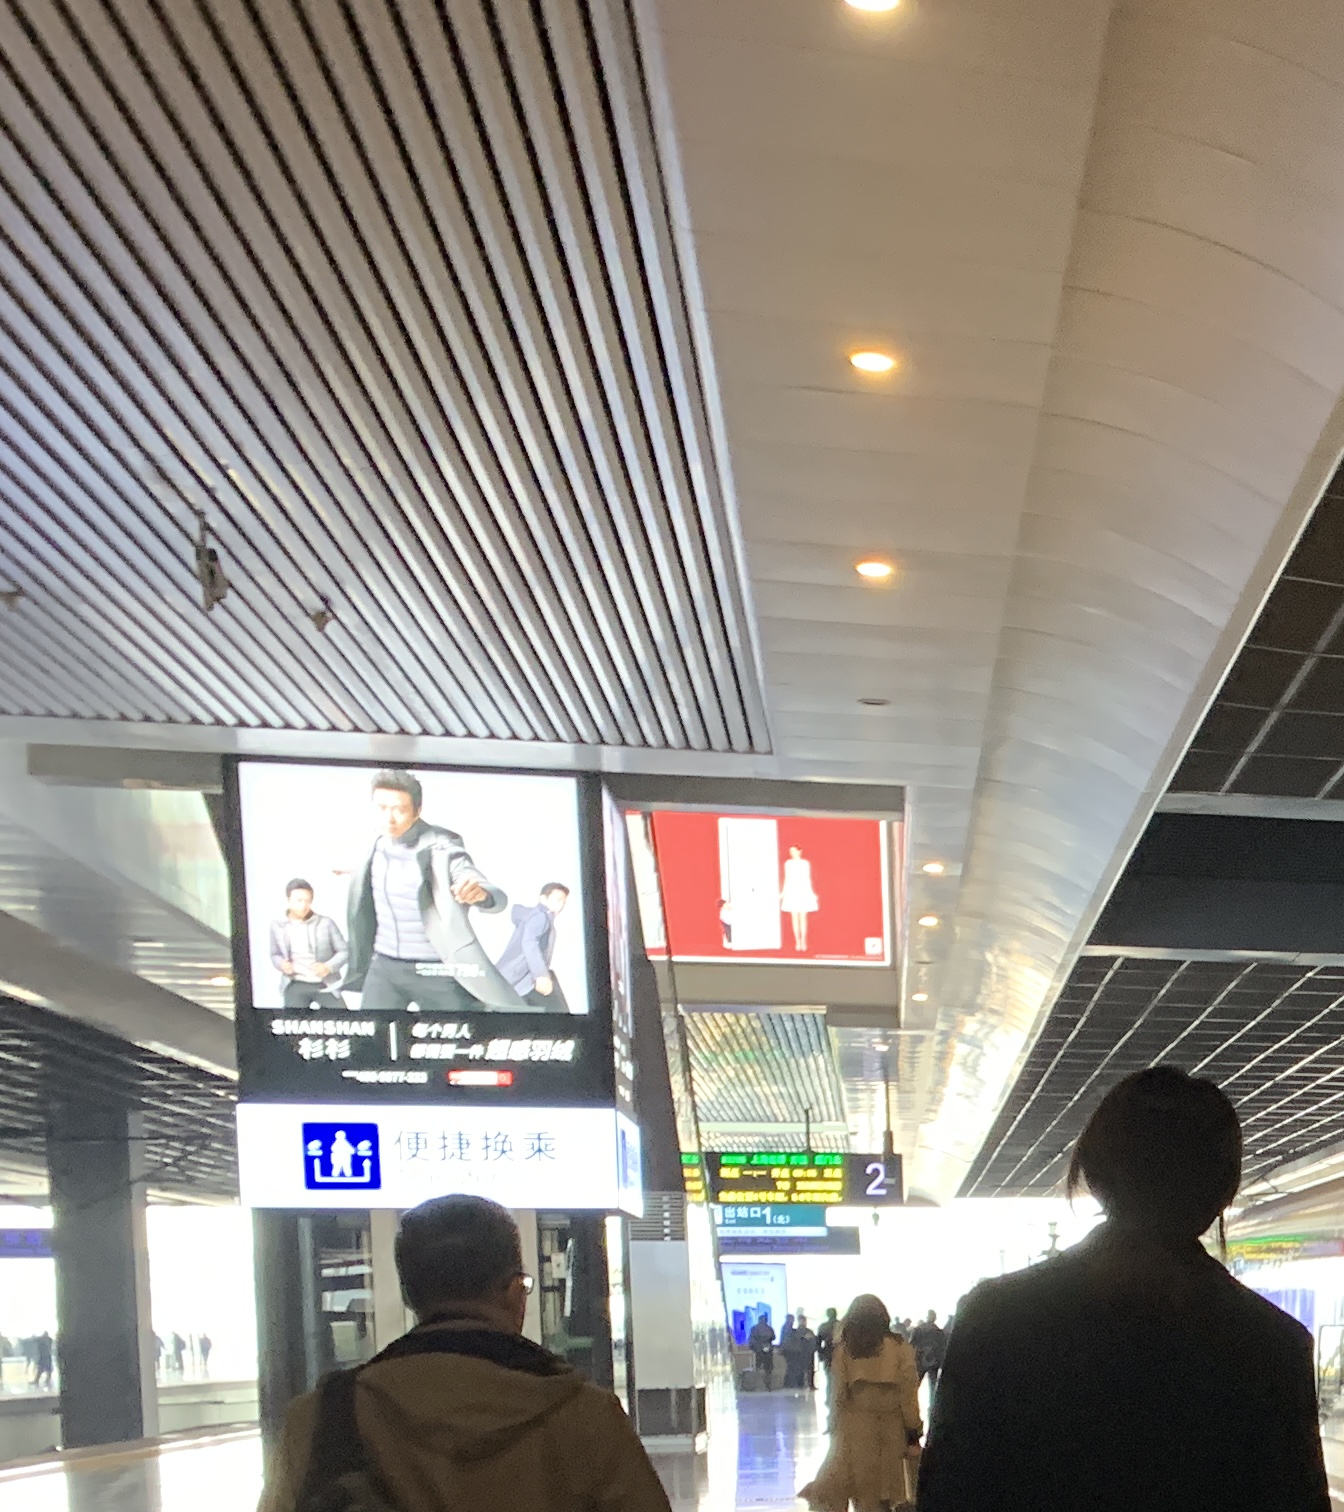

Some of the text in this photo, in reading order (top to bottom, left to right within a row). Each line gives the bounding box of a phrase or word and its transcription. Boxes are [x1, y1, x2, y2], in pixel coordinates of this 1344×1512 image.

[271, 1019, 376, 1037] SHANSHAN
[297, 1037, 351, 1061] 杉杉
[394, 1129, 557, 1162] 便捷换乘
[864, 1161, 888, 1196] 2
